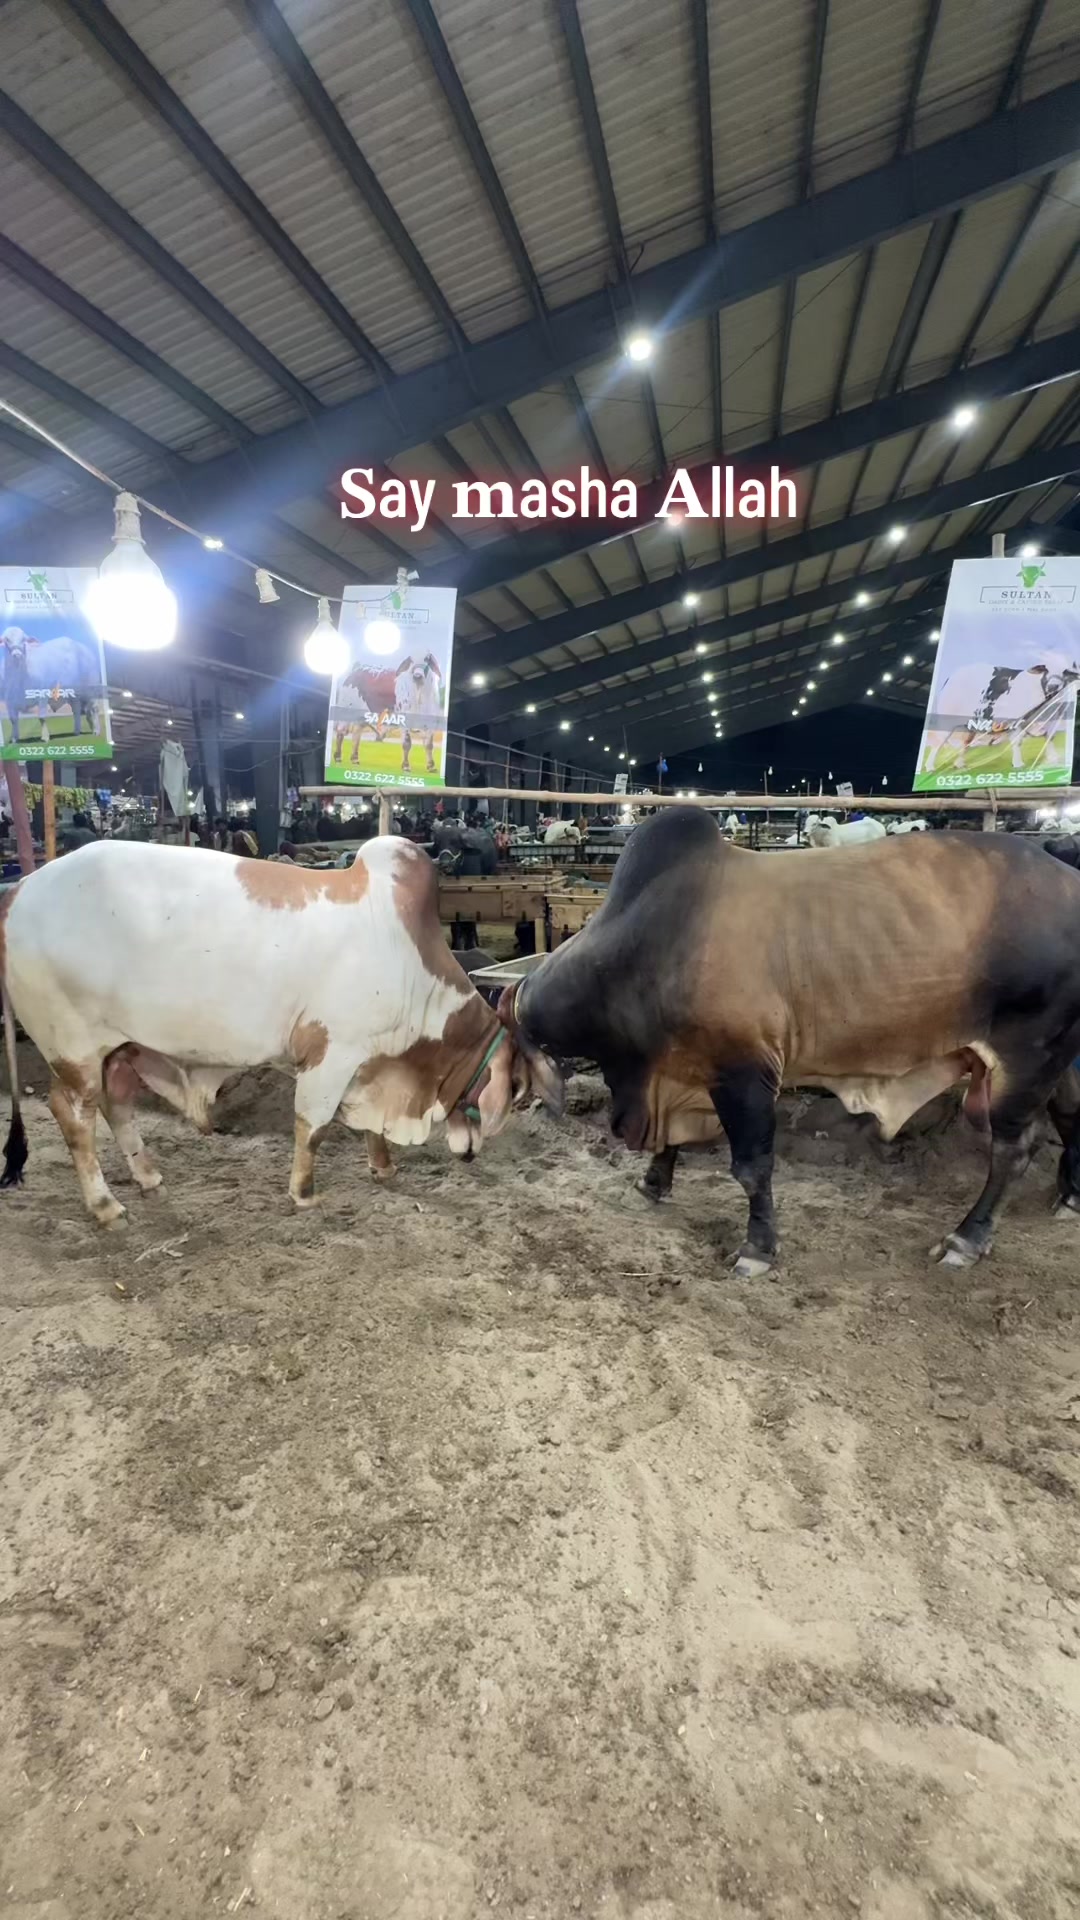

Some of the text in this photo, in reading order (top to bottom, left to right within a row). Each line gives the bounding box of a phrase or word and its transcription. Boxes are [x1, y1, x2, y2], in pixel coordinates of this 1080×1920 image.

[21, 592, 57, 600] SULTAN
[1001, 590, 1052, 599] SULTAN
[380, 611, 415, 619] ULTAN
[19, 745, 94, 756] 0322 622 5555
[344, 770, 425, 787] 0322 622 5555
[936, 770, 1044, 786] 0322 622 5555
